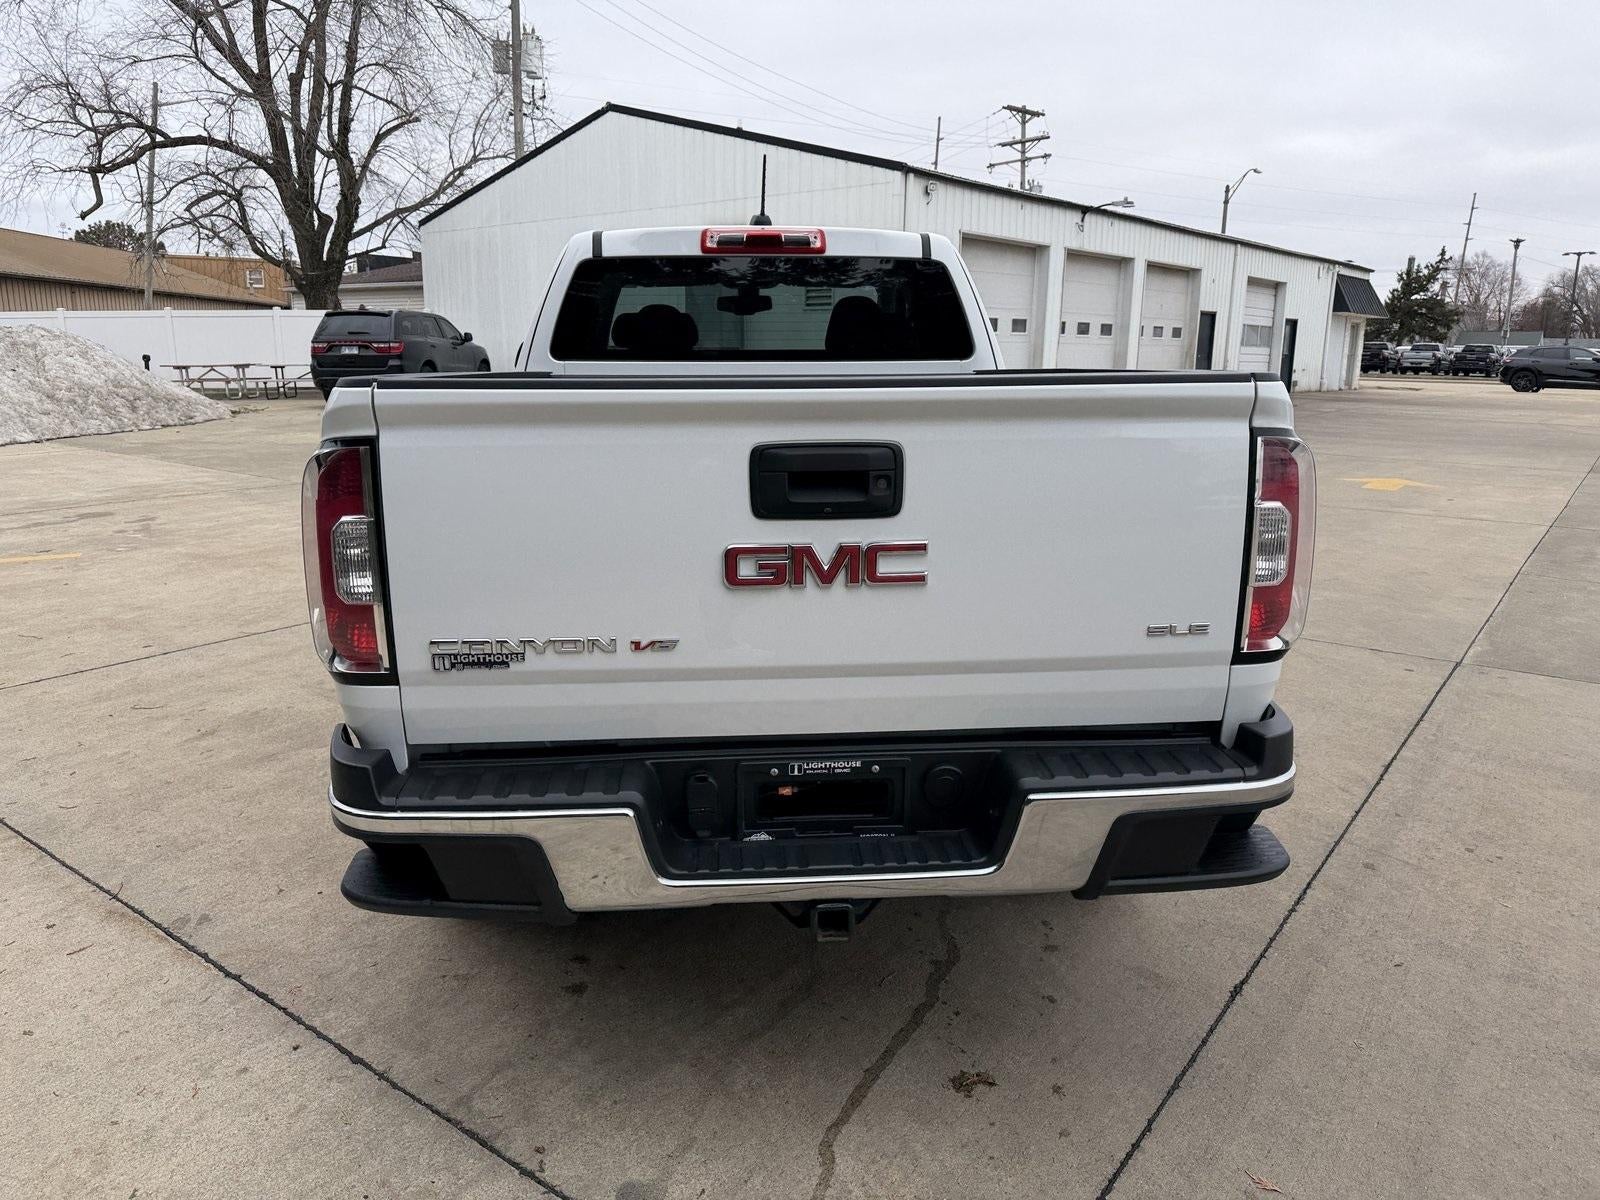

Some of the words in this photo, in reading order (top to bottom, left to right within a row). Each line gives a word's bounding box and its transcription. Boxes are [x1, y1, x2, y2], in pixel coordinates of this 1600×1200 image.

[723, 539, 929, 589] GMC
[1146, 622, 1211, 636] SLE
[429, 636, 617, 654] CANYON
[630, 639, 680, 652] V6
[450, 653, 525, 663] LIGHTHOUSE
[803, 760, 862, 769] LIGHTHOUSE
